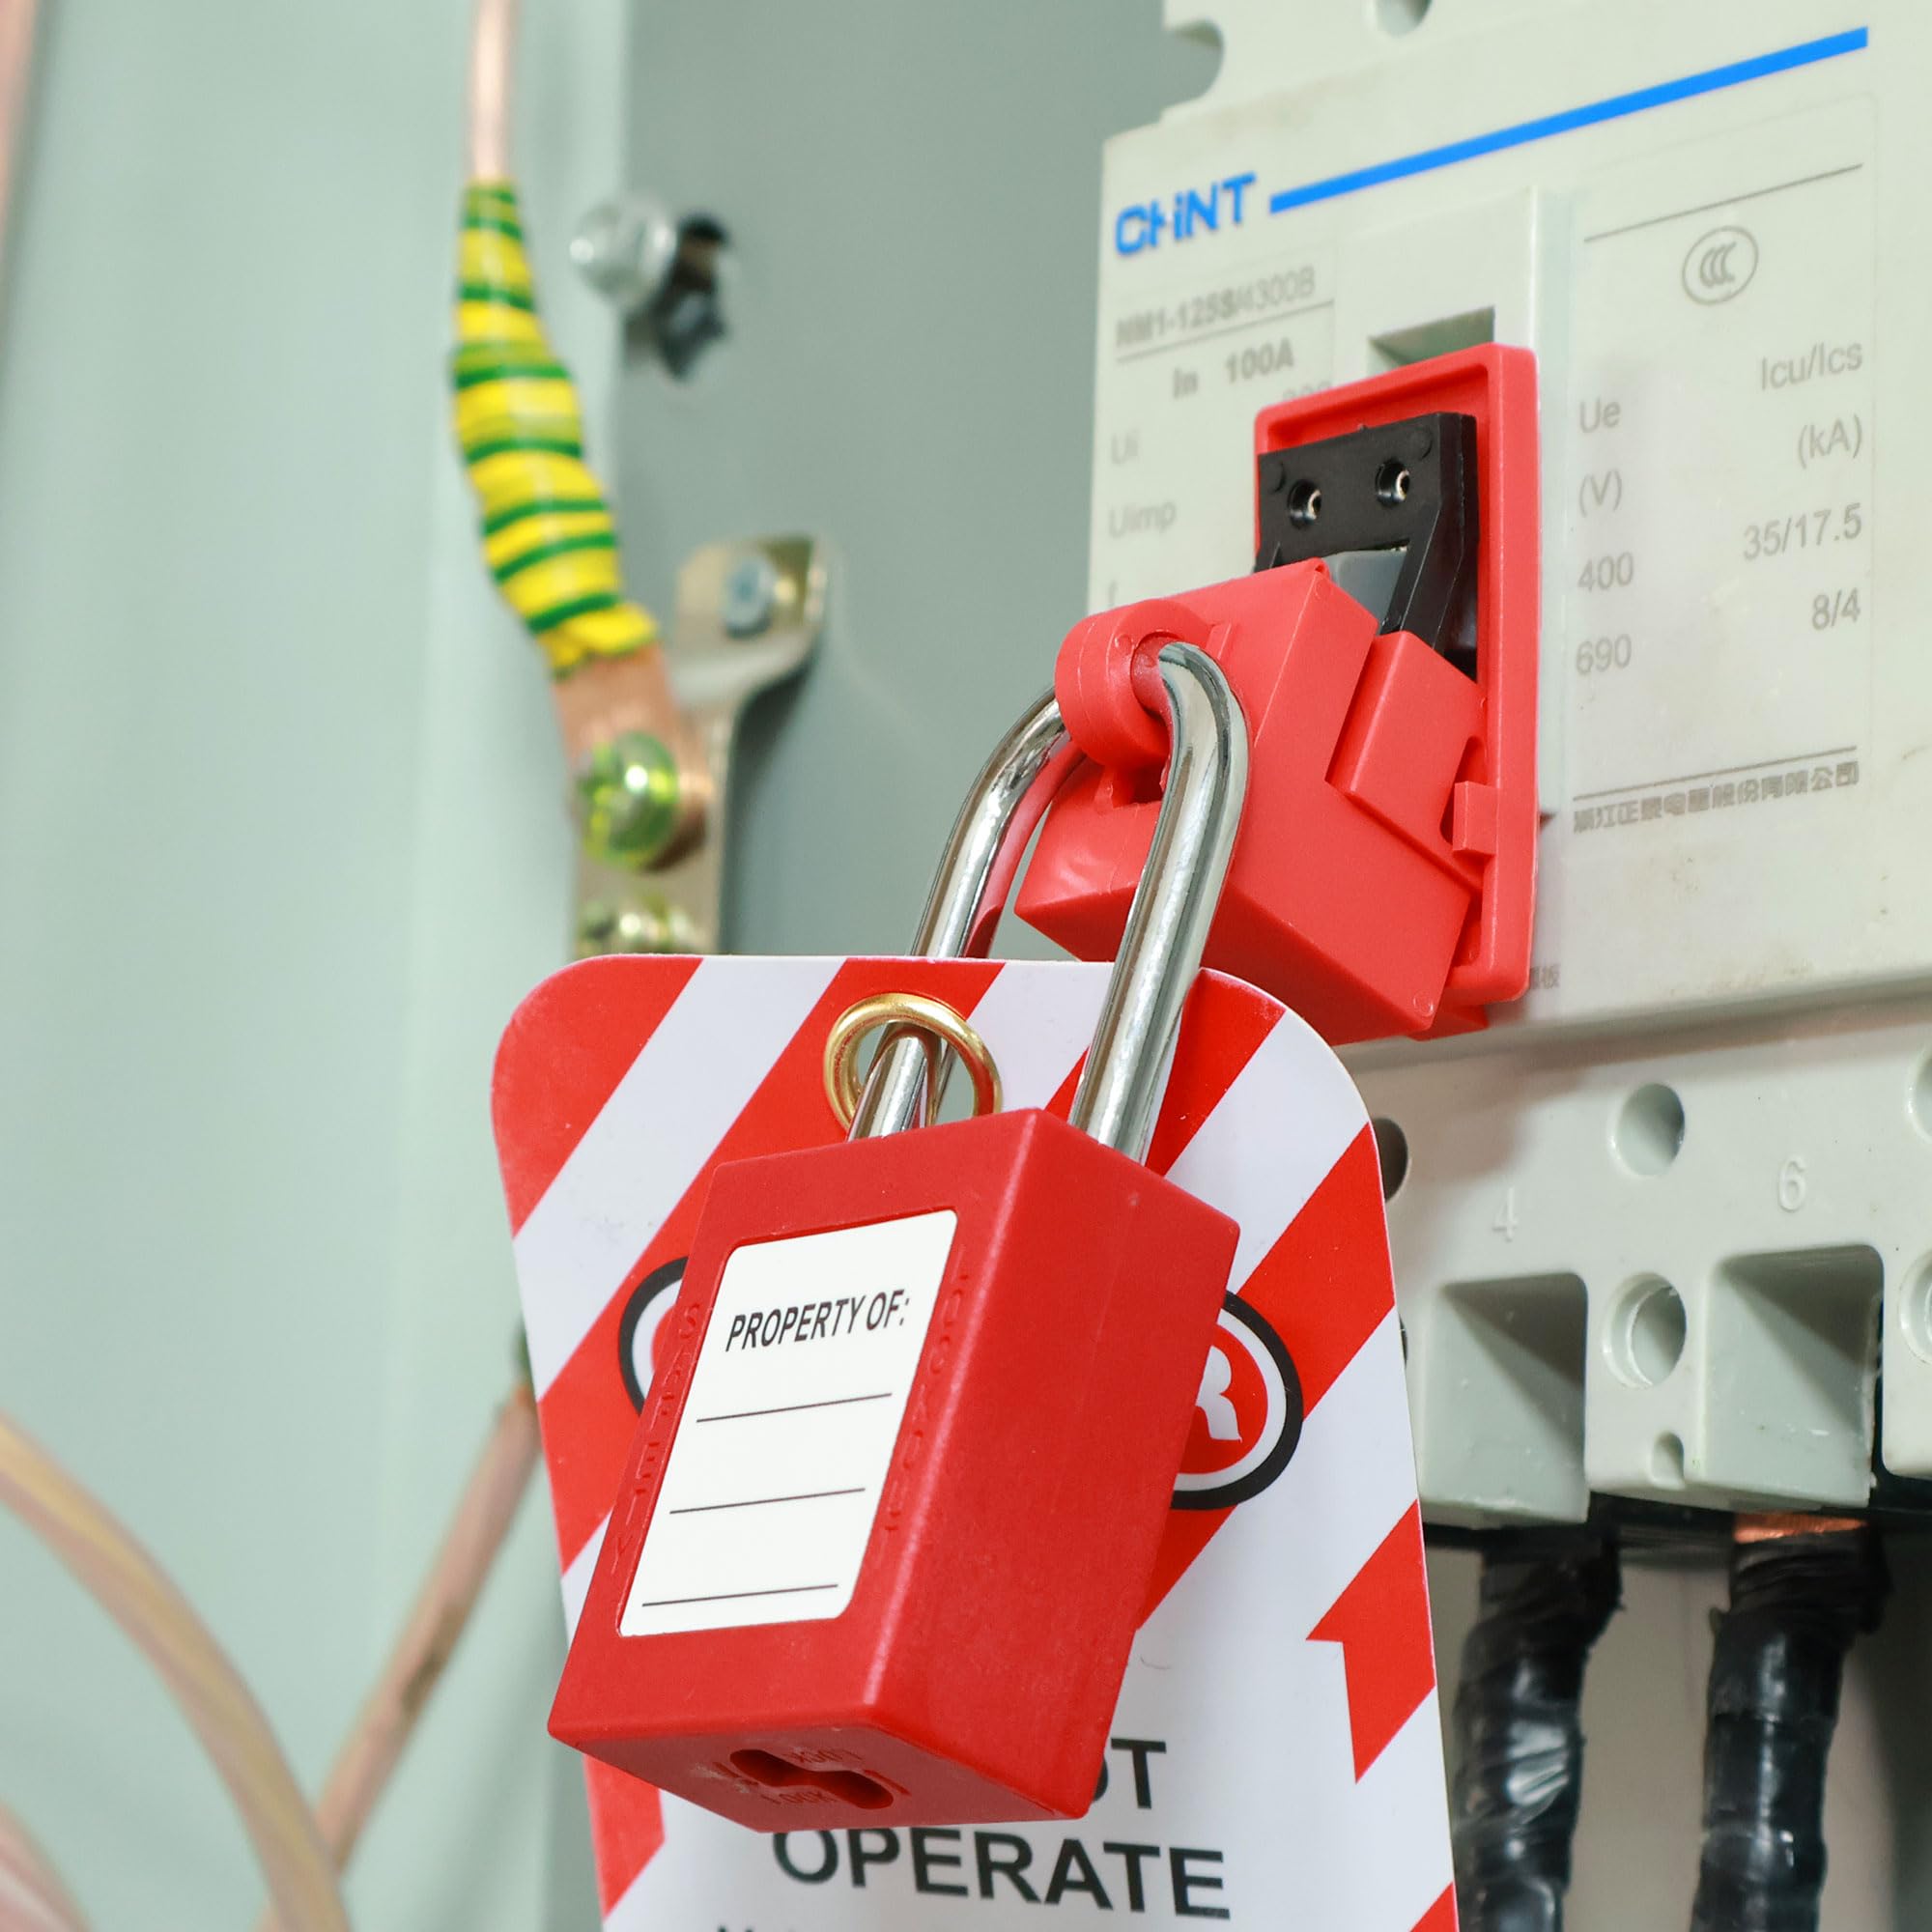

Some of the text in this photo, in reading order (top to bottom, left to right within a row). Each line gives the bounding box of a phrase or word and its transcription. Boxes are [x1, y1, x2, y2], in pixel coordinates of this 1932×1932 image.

[1225, 336, 1295, 384] 100A
[1760, 342, 1863, 390] Icu/Ics
[1579, 398, 1621, 434] Ue
[1798, 413, 1862, 469] (kA)
[1578, 469, 1623, 517] (V)
[1743, 501, 1862, 561] 35/17.5
[1577, 551, 1634, 592] 400
[1811, 587, 1861, 631] 8/4
[1576, 633, 1632, 675] 690
[1776, 1155, 1807, 1213] 6
[1492, 1185, 1519, 1243] 4
[725, 1288, 910, 1352] PROPERTY OF:
[773, 1828, 1231, 1920] OPERATE
